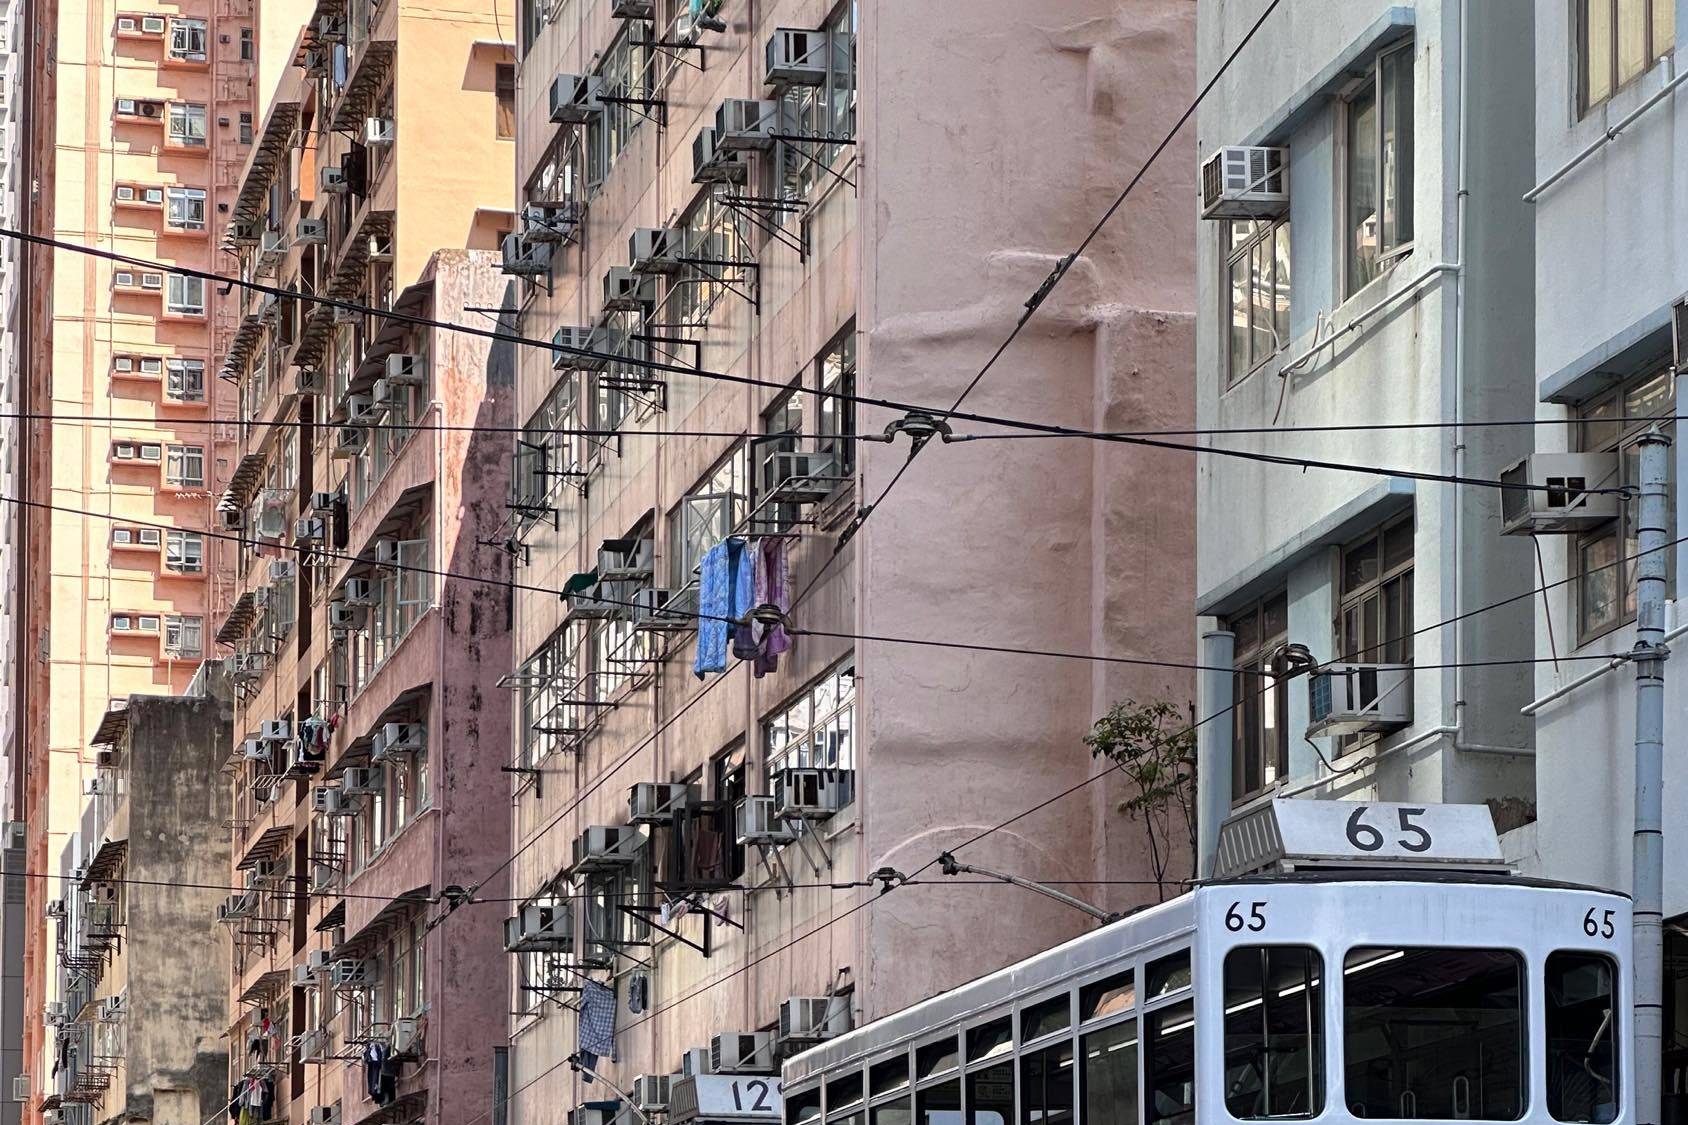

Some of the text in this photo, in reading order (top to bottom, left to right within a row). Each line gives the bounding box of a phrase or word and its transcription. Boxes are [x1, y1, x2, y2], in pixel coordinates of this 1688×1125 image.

[1346, 806, 1432, 852] 65
[1224, 901, 1267, 932] 65
[1583, 907, 1616, 939] 65
[732, 1080, 782, 1111] 12
